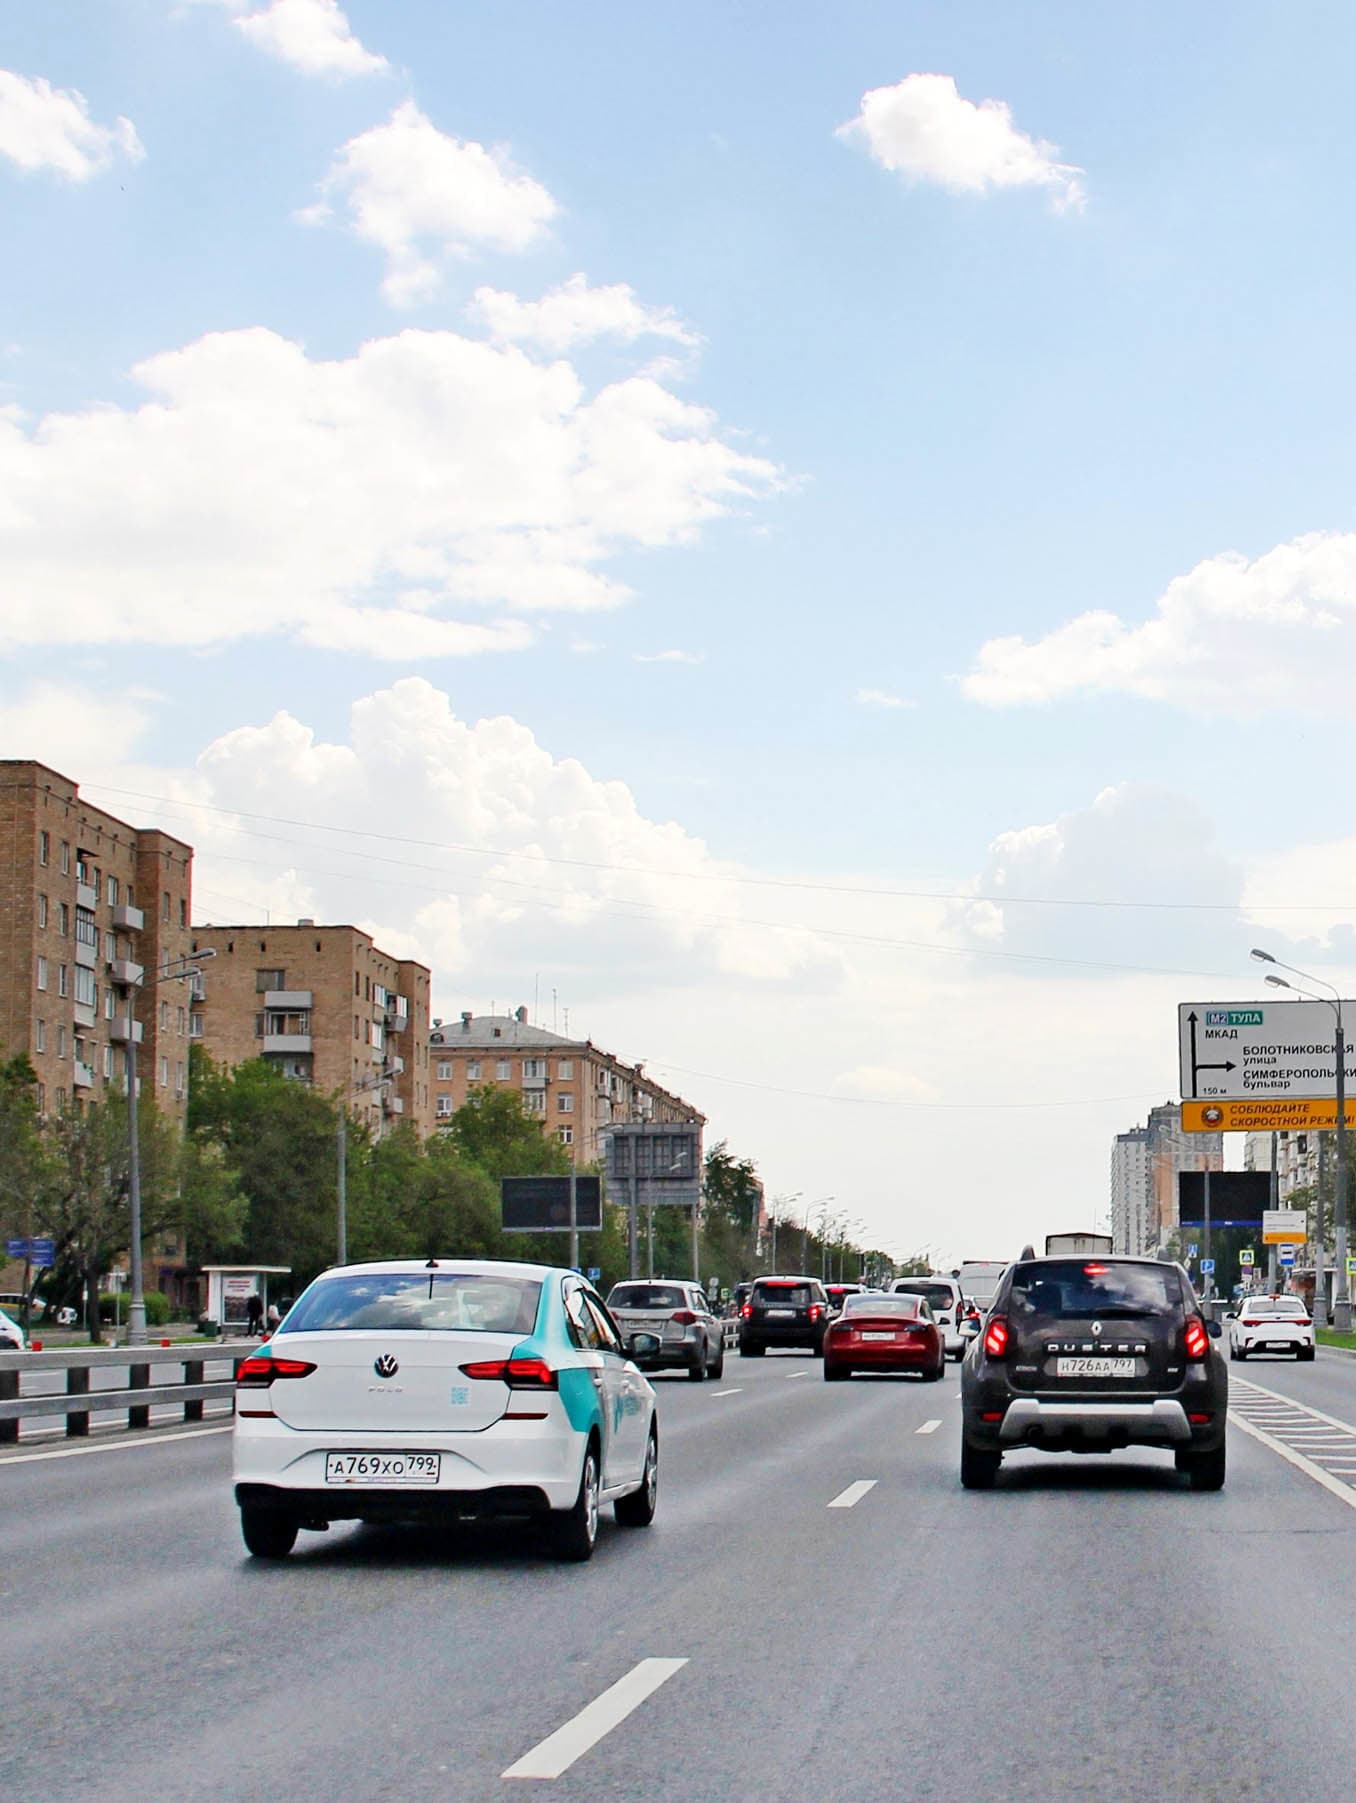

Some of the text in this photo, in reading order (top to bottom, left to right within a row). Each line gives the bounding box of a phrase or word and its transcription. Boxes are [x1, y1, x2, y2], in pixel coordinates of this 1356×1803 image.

[1210, 1013, 1261, 1024] М2 ТУЛА
[1204, 1029, 1238, 1040] МКАД
[1242, 1044, 1354, 1056] БОЛОТНИКОВСКЯ
[1243, 1057, 1277, 1066] улица
[1243, 1079, 1291, 1090] бульвар
[1203, 1087, 1217, 1095] 150
[1230, 1103, 1310, 1115] СОБЛЮДАЙТЕ
[1230, 1115, 1307, 1127] СКОРОСТНОЙ
[1047, 1344, 1146, 1352] DUSTER
[368, 1385, 403, 1393] POLO
[334, 1456, 434, 1474] А769ХО 799
